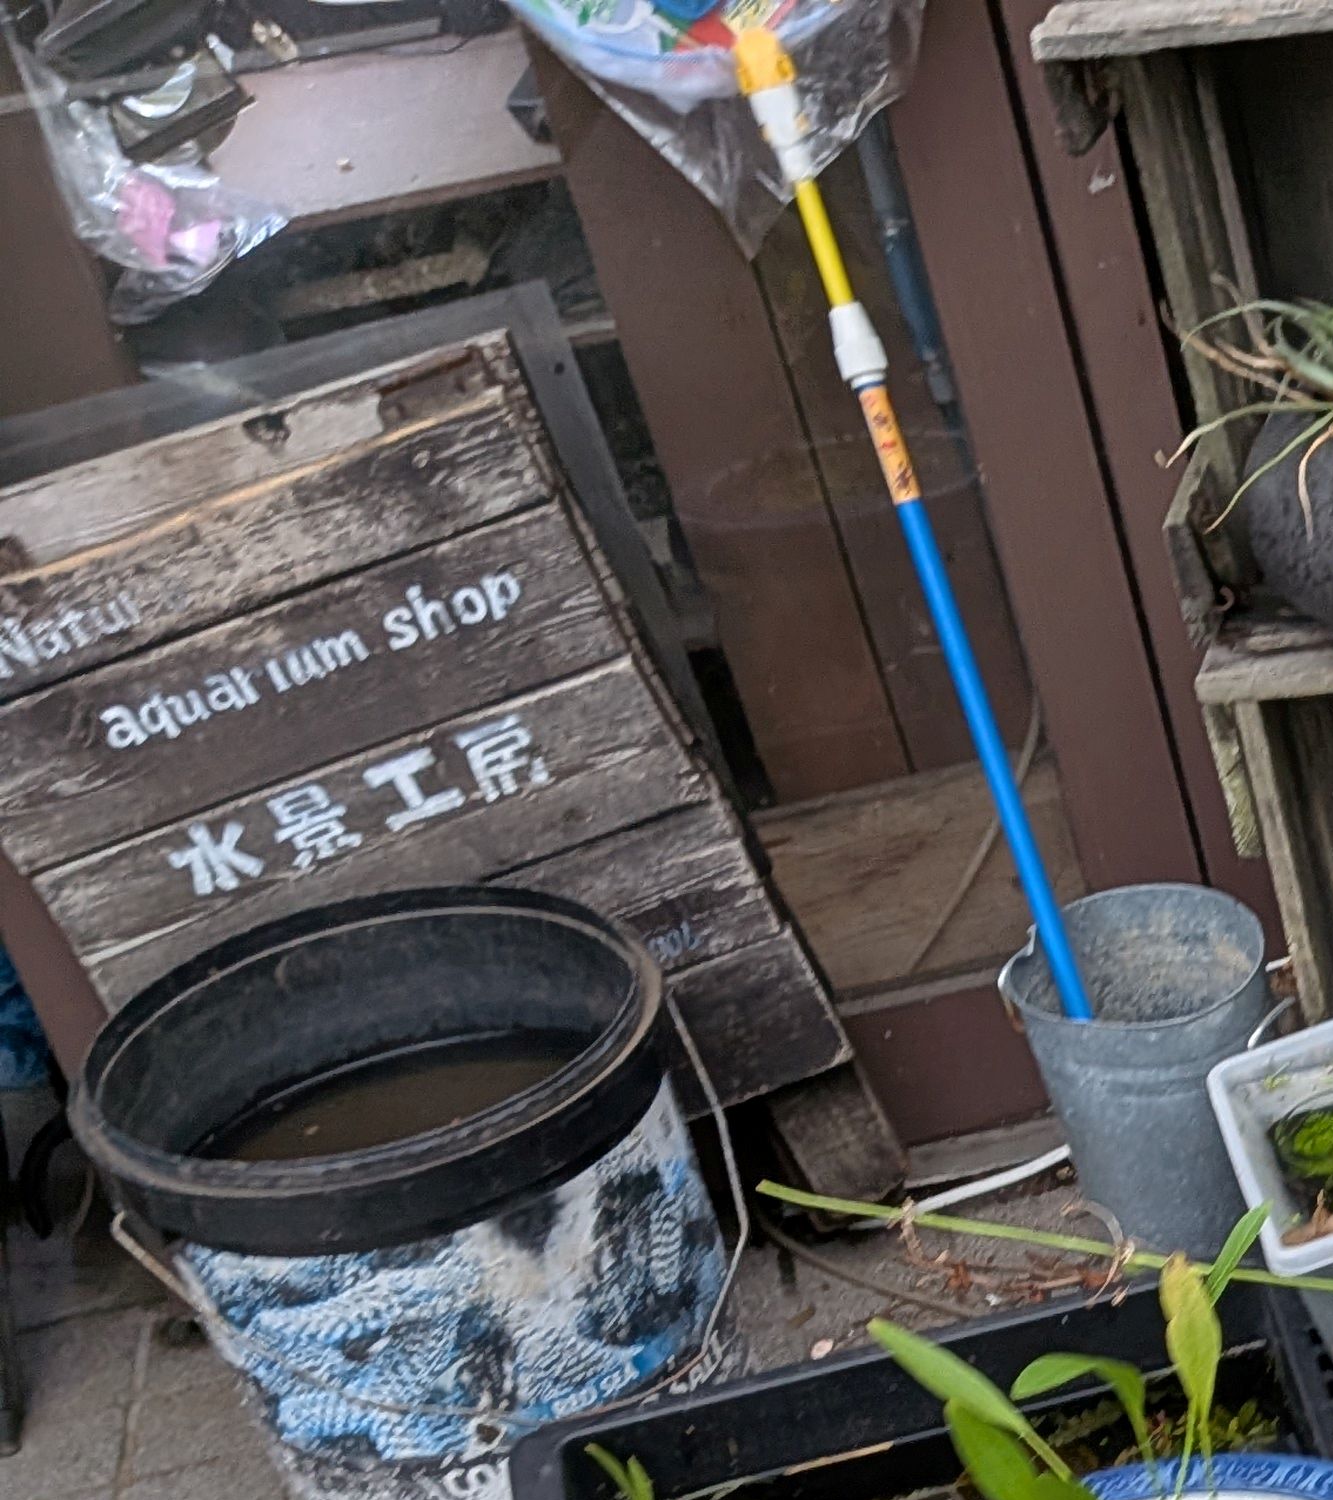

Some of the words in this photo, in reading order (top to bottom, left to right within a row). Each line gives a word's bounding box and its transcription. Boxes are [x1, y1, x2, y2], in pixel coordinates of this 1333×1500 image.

[98, 628, 371, 751] aquarium
[382, 570, 523, 653] shop
[167, 713, 552, 897] 水景工房
